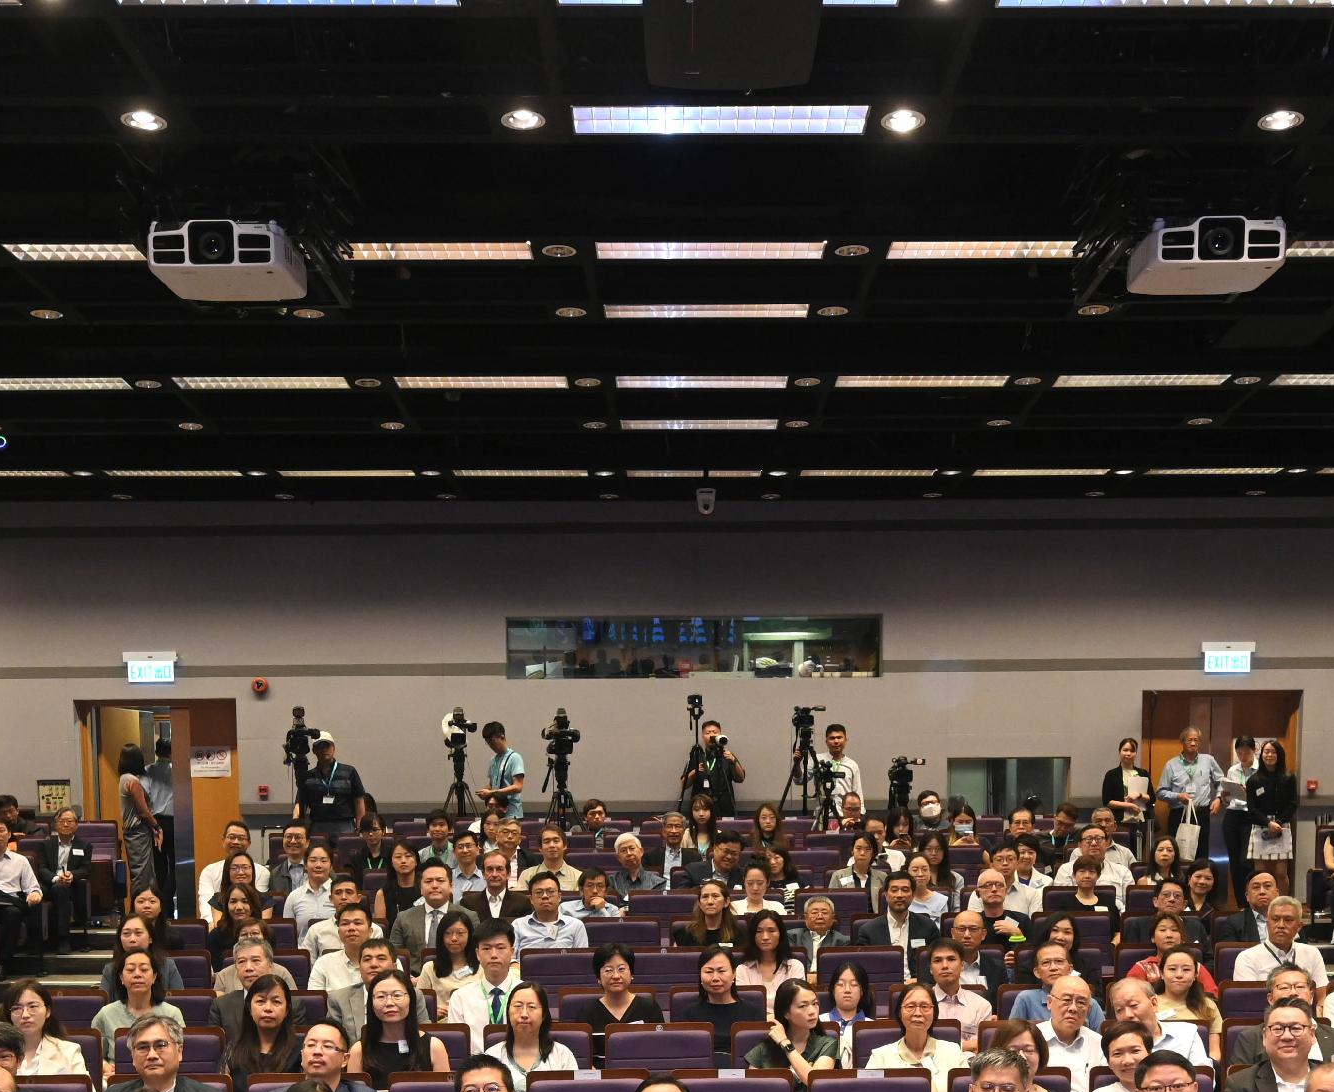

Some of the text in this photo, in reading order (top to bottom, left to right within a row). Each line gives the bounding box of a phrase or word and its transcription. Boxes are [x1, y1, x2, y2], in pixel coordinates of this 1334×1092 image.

[1207, 655, 1249, 670] EXIT 出口
[130, 664, 172, 680] EXIT 出口
